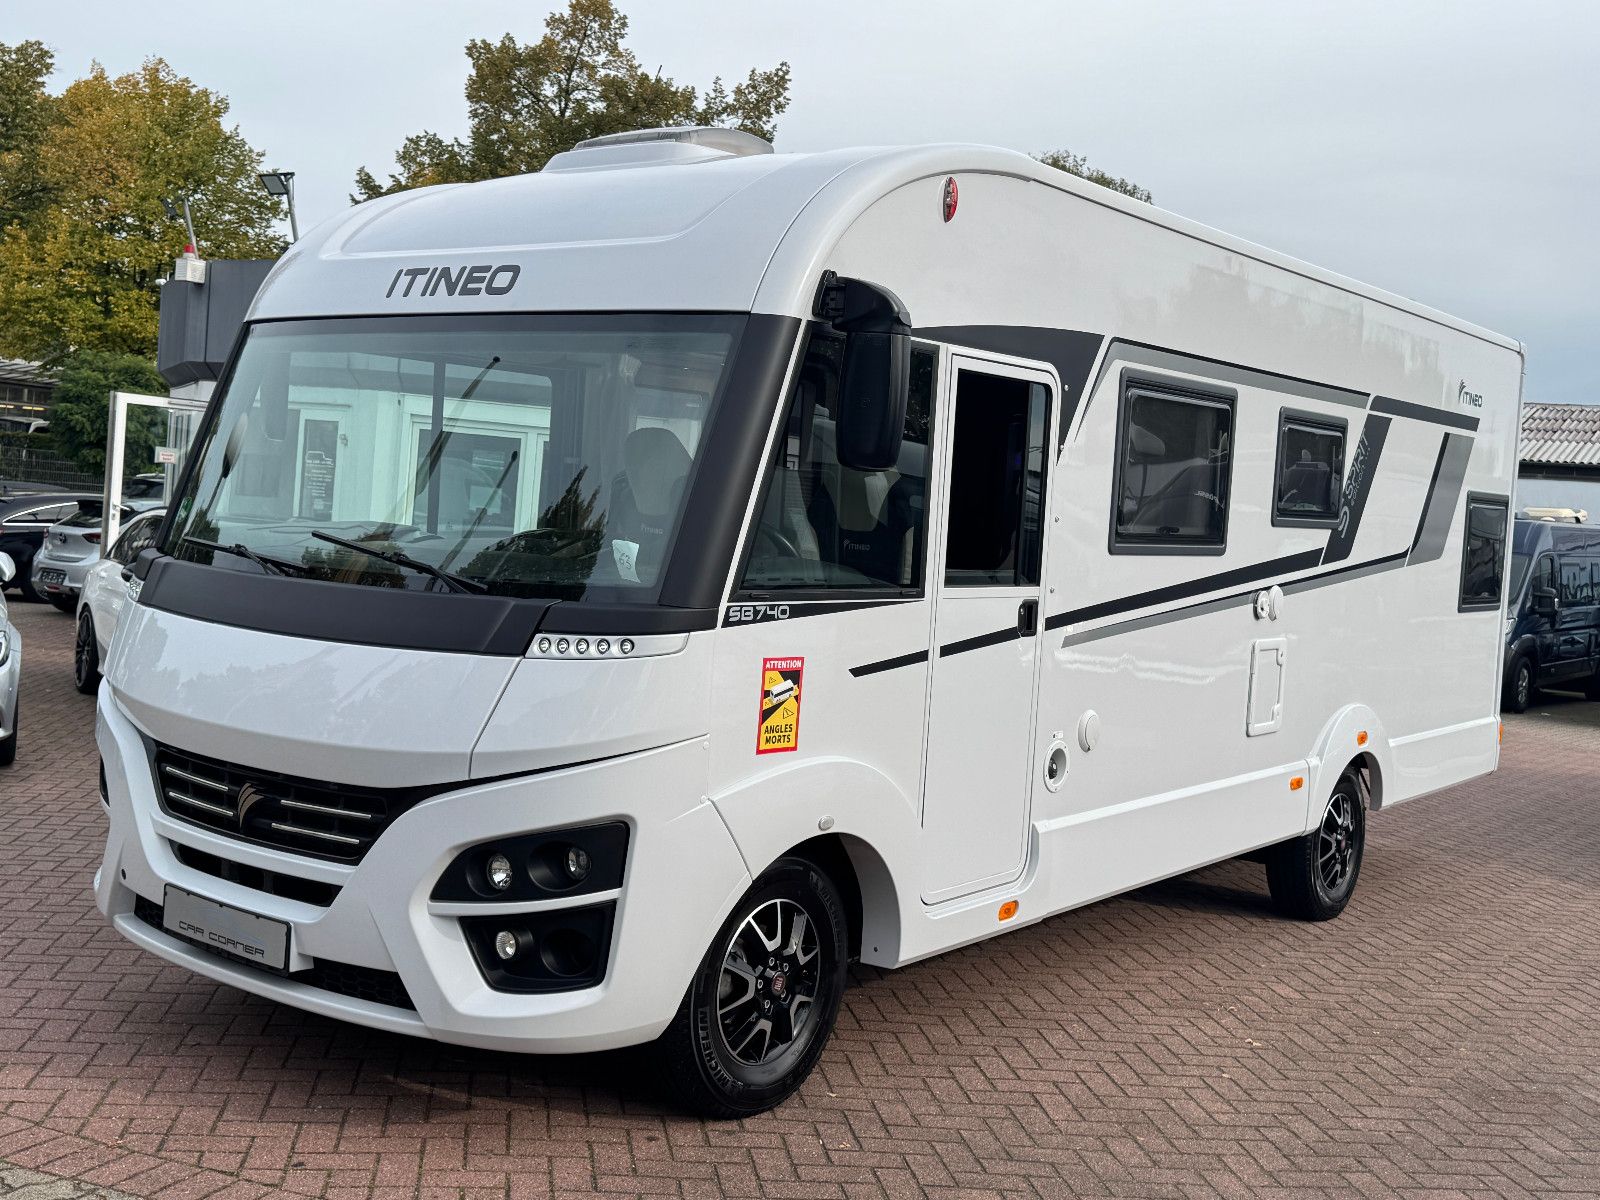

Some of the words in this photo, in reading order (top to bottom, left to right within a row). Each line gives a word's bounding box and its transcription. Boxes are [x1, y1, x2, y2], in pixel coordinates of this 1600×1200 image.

[385, 264, 522, 299] ITINEO
[1462, 391, 1483, 408] ITINEO
[1345, 427, 1369, 500] SPIRIT
[765, 659, 802, 669] ATTENTION
[764, 723, 793, 735] ANGLES
[764, 734, 791, 745] MORTS
[179, 921, 205, 937] CAR
[208, 932, 265, 958] CORNER
[697, 1006, 735, 1092] MICHELIN
